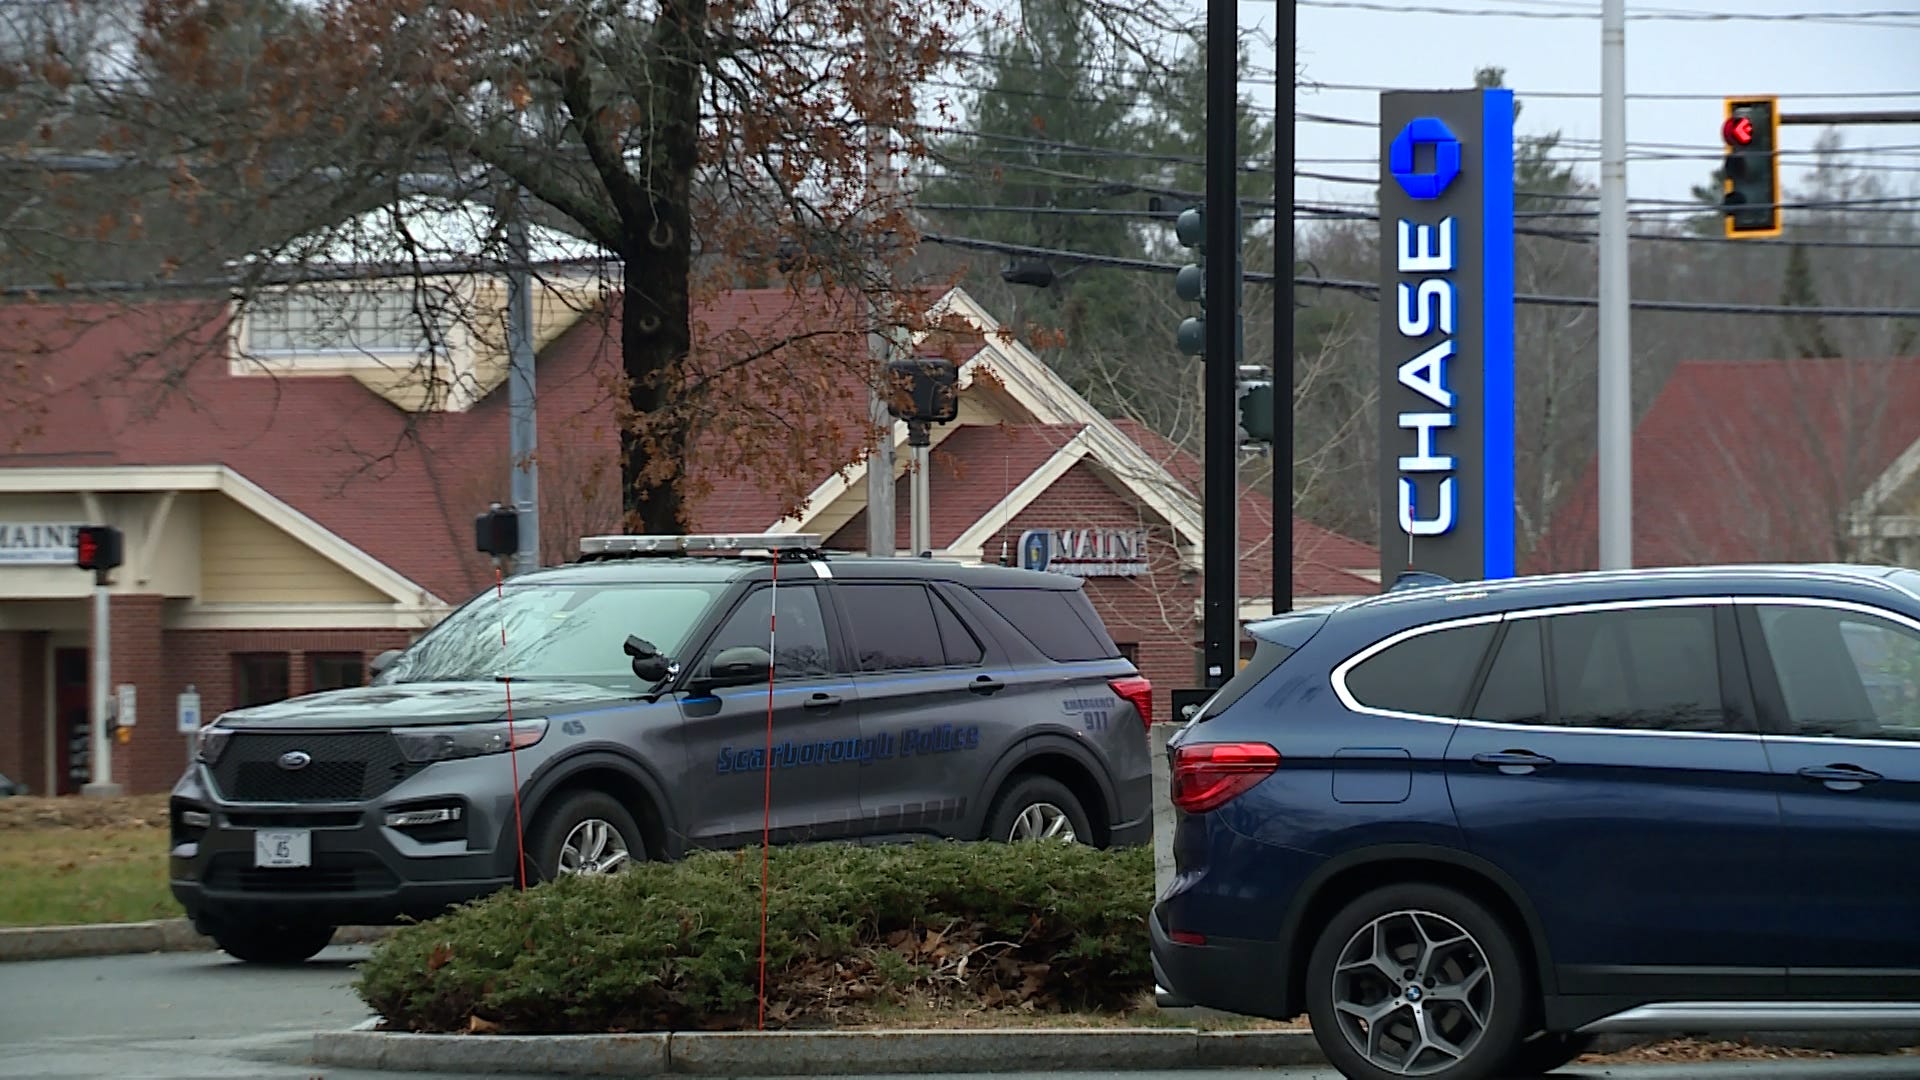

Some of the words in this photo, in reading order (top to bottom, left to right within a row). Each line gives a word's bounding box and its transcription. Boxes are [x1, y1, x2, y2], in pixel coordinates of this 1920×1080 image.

[1399, 215, 1457, 536] CHASE
[1051, 529, 1148, 559] MAINE
[1083, 710, 1108, 731] 911
[718, 734, 895, 773] Scarborough
[901, 724, 980, 757] Police
